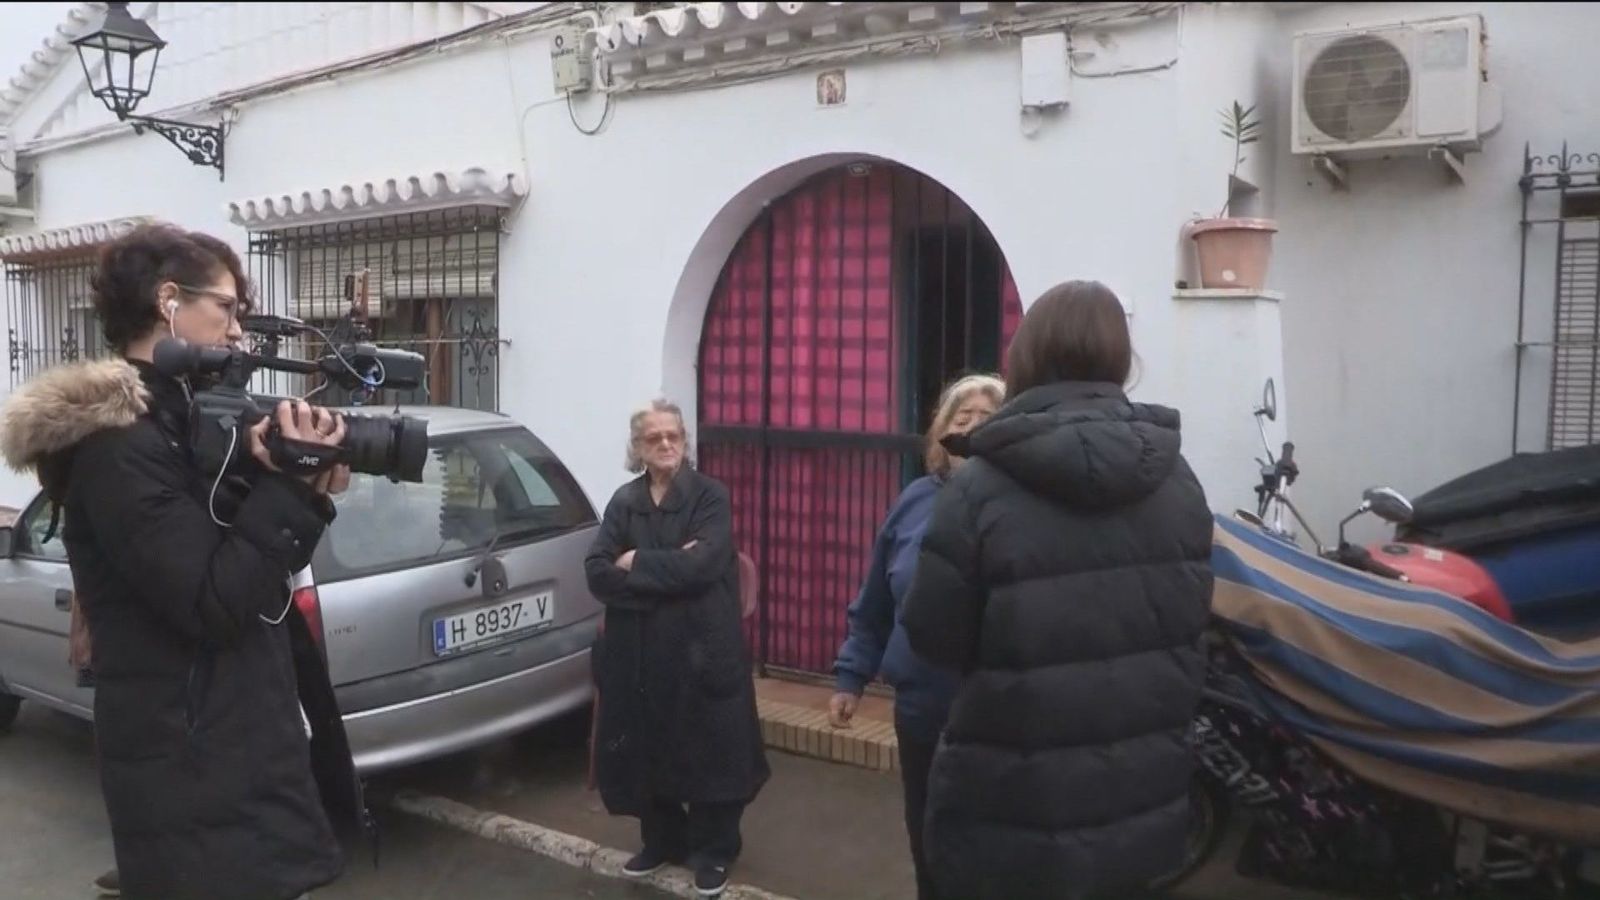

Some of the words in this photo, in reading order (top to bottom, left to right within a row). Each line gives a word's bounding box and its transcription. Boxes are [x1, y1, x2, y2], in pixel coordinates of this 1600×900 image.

[298, 455, 319, 466] JVC
[452, 618, 465, 643] H
[475, 603, 523, 636] 8937
[536, 596, 547, 619] V
